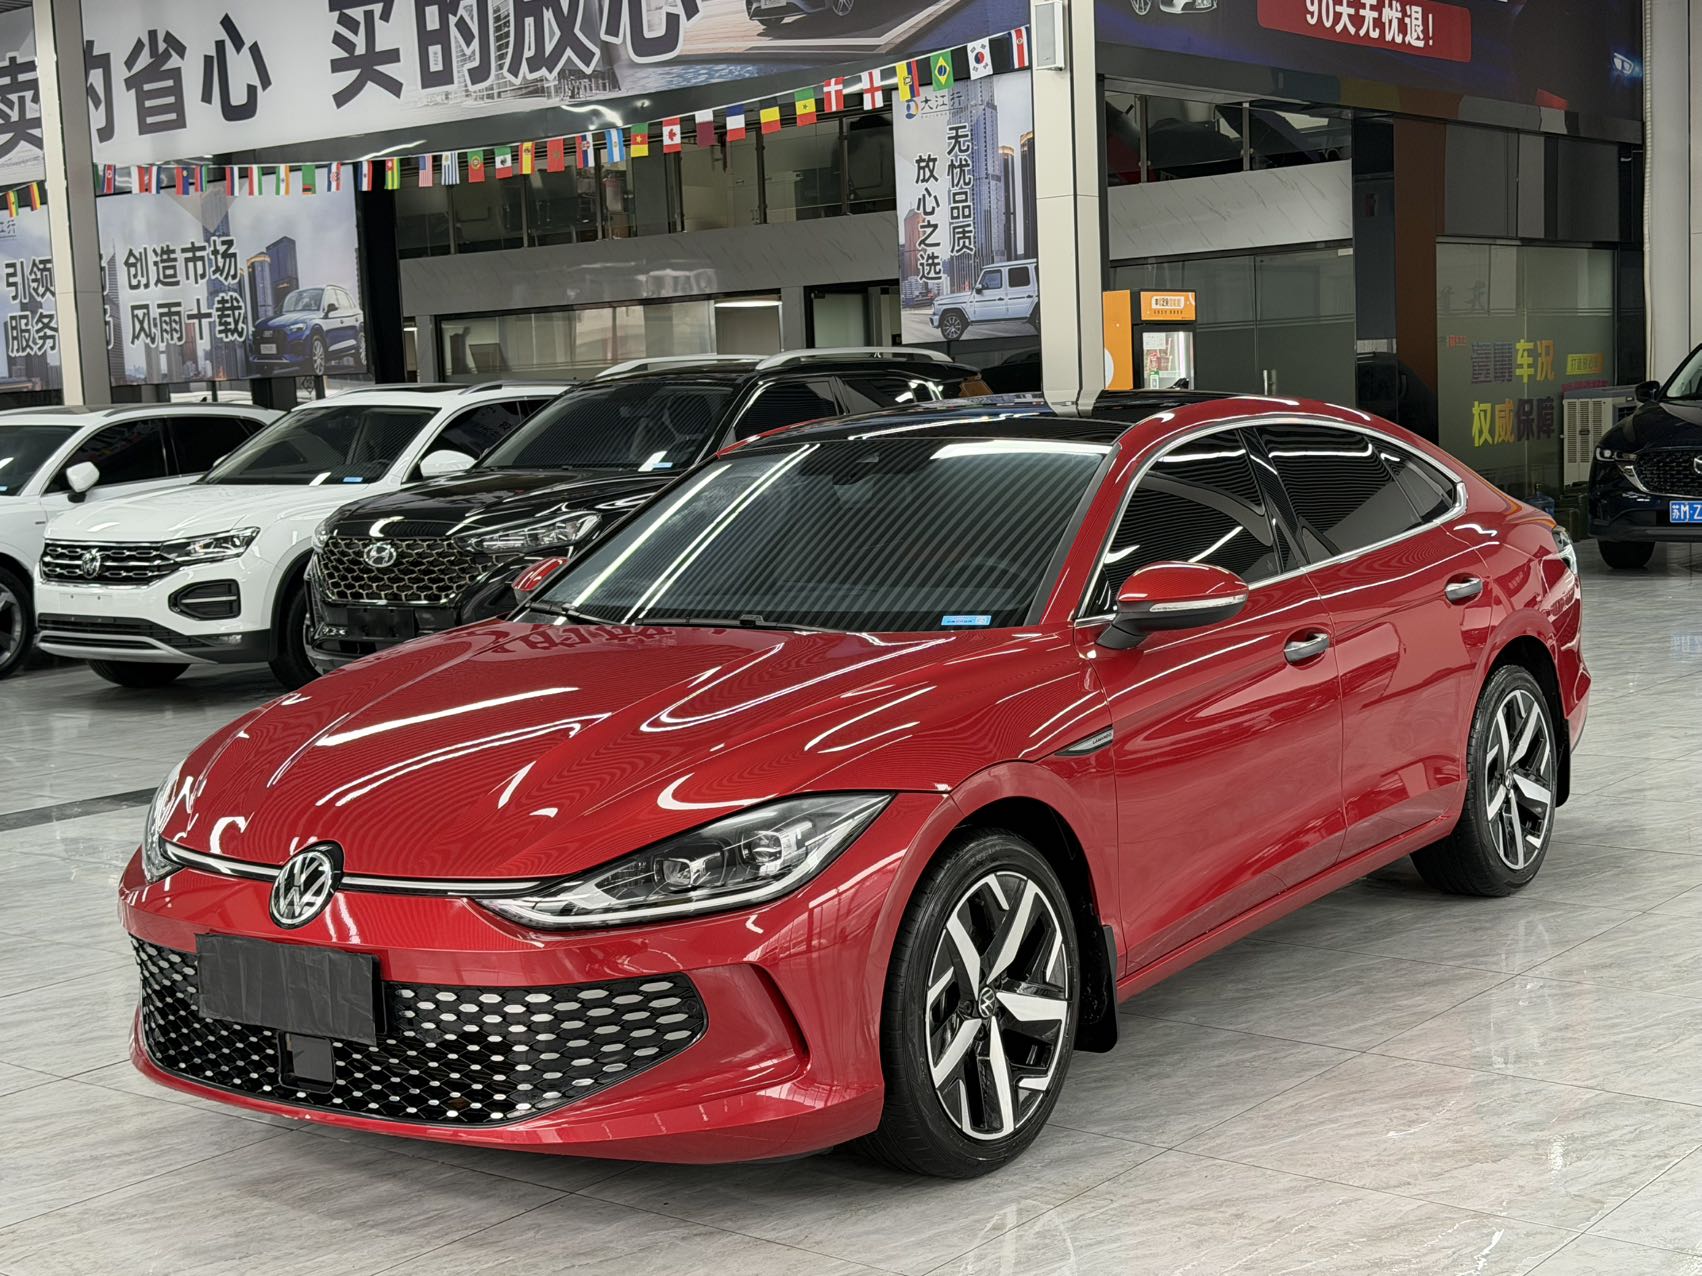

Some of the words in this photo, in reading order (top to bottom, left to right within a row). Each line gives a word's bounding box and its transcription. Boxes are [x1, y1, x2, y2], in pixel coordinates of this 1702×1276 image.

[329, 0, 699, 109] 买的放心
[914, 154, 943, 283] 放心之选
[947, 123, 975, 255] 无忧品质
[124, 237, 240, 291] 创造市场
[130, 294, 247, 347] 风雨十载
[1472, 397, 1556, 448] 权威保障
